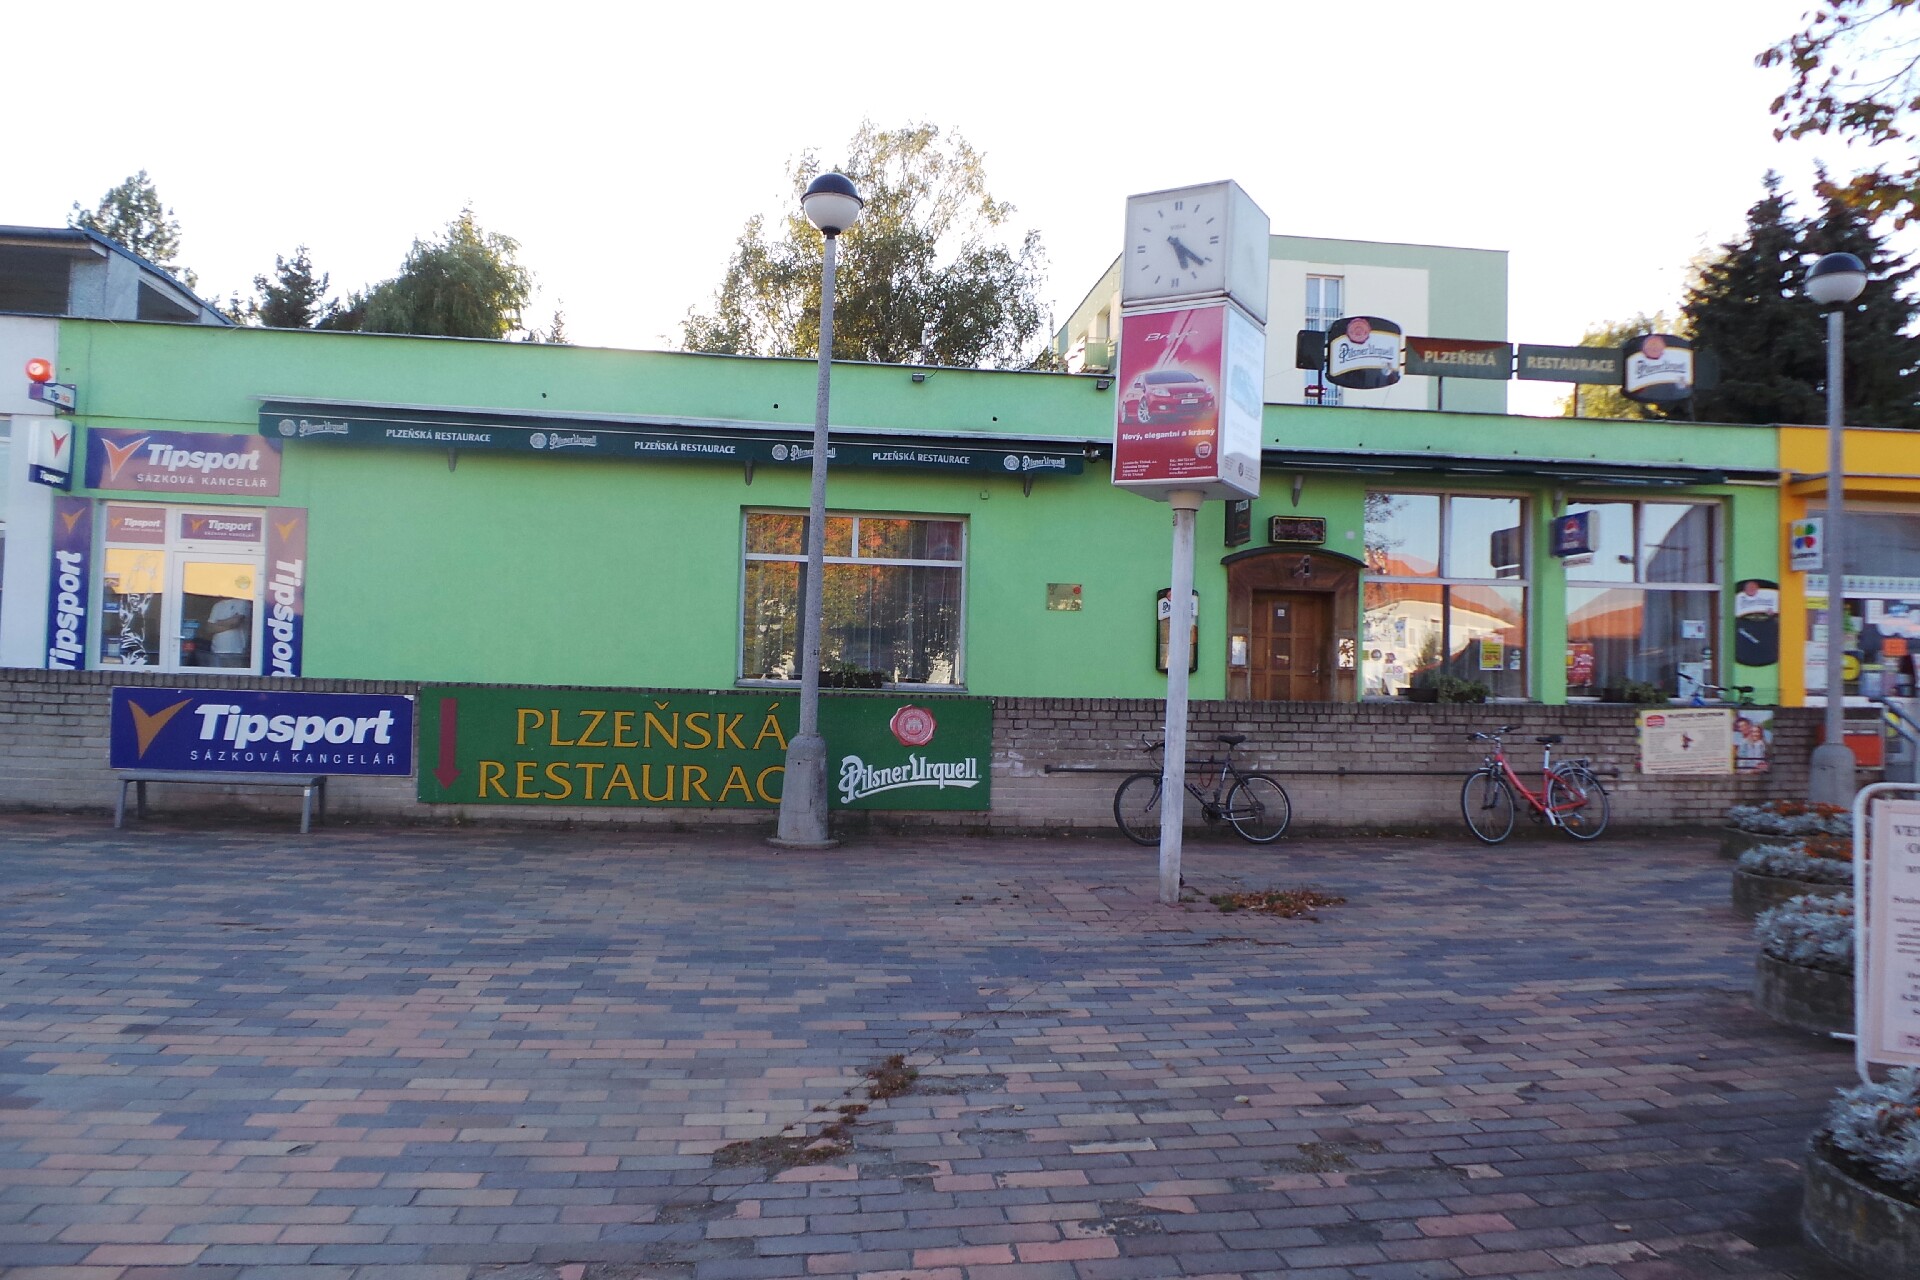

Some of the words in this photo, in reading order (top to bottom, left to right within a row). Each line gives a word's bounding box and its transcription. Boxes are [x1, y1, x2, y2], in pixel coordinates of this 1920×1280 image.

[1339, 343, 1369, 363] Pilsner
[1368, 344, 1394, 357] Urquell
[1424, 349, 1496, 366] PLZEŇSKÁ
[1527, 356, 1615, 372] RESTAURACE
[386, 428, 433, 440] PLZEŇSKÁ
[434, 431, 491, 442] RESTAURACE
[634, 440, 679, 451] PLZEŇSKÁ
[680, 443, 736, 454] RESTAURACE
[147, 443, 260, 474] Tipsport
[872, 450, 915, 461] PLZEŇSKÁ
[917, 453, 970, 465] RESTAURACE
[1022, 455, 1044, 471] Pilsner
[1043, 455, 1066, 468] Urquell
[137, 473, 194, 484] SÁZKOVÁ
[202, 477, 267, 488] KANCELÁŘ
[124, 517, 161, 528] Tipsport
[208, 519, 253, 531] Tipsport
[49, 550, 84, 670] Tipsport
[194, 704, 395, 750] Tipsport
[516, 701, 789, 751] PLZEŇSKÁ
[190, 749, 280, 763] SÁZKOVÁ
[292, 752, 395, 765] KANCELÁŘ
[477, 760, 786, 804] RESTAURAC
[838, 755, 911, 804] Pilsner
[909, 752, 978, 790] Urquell
